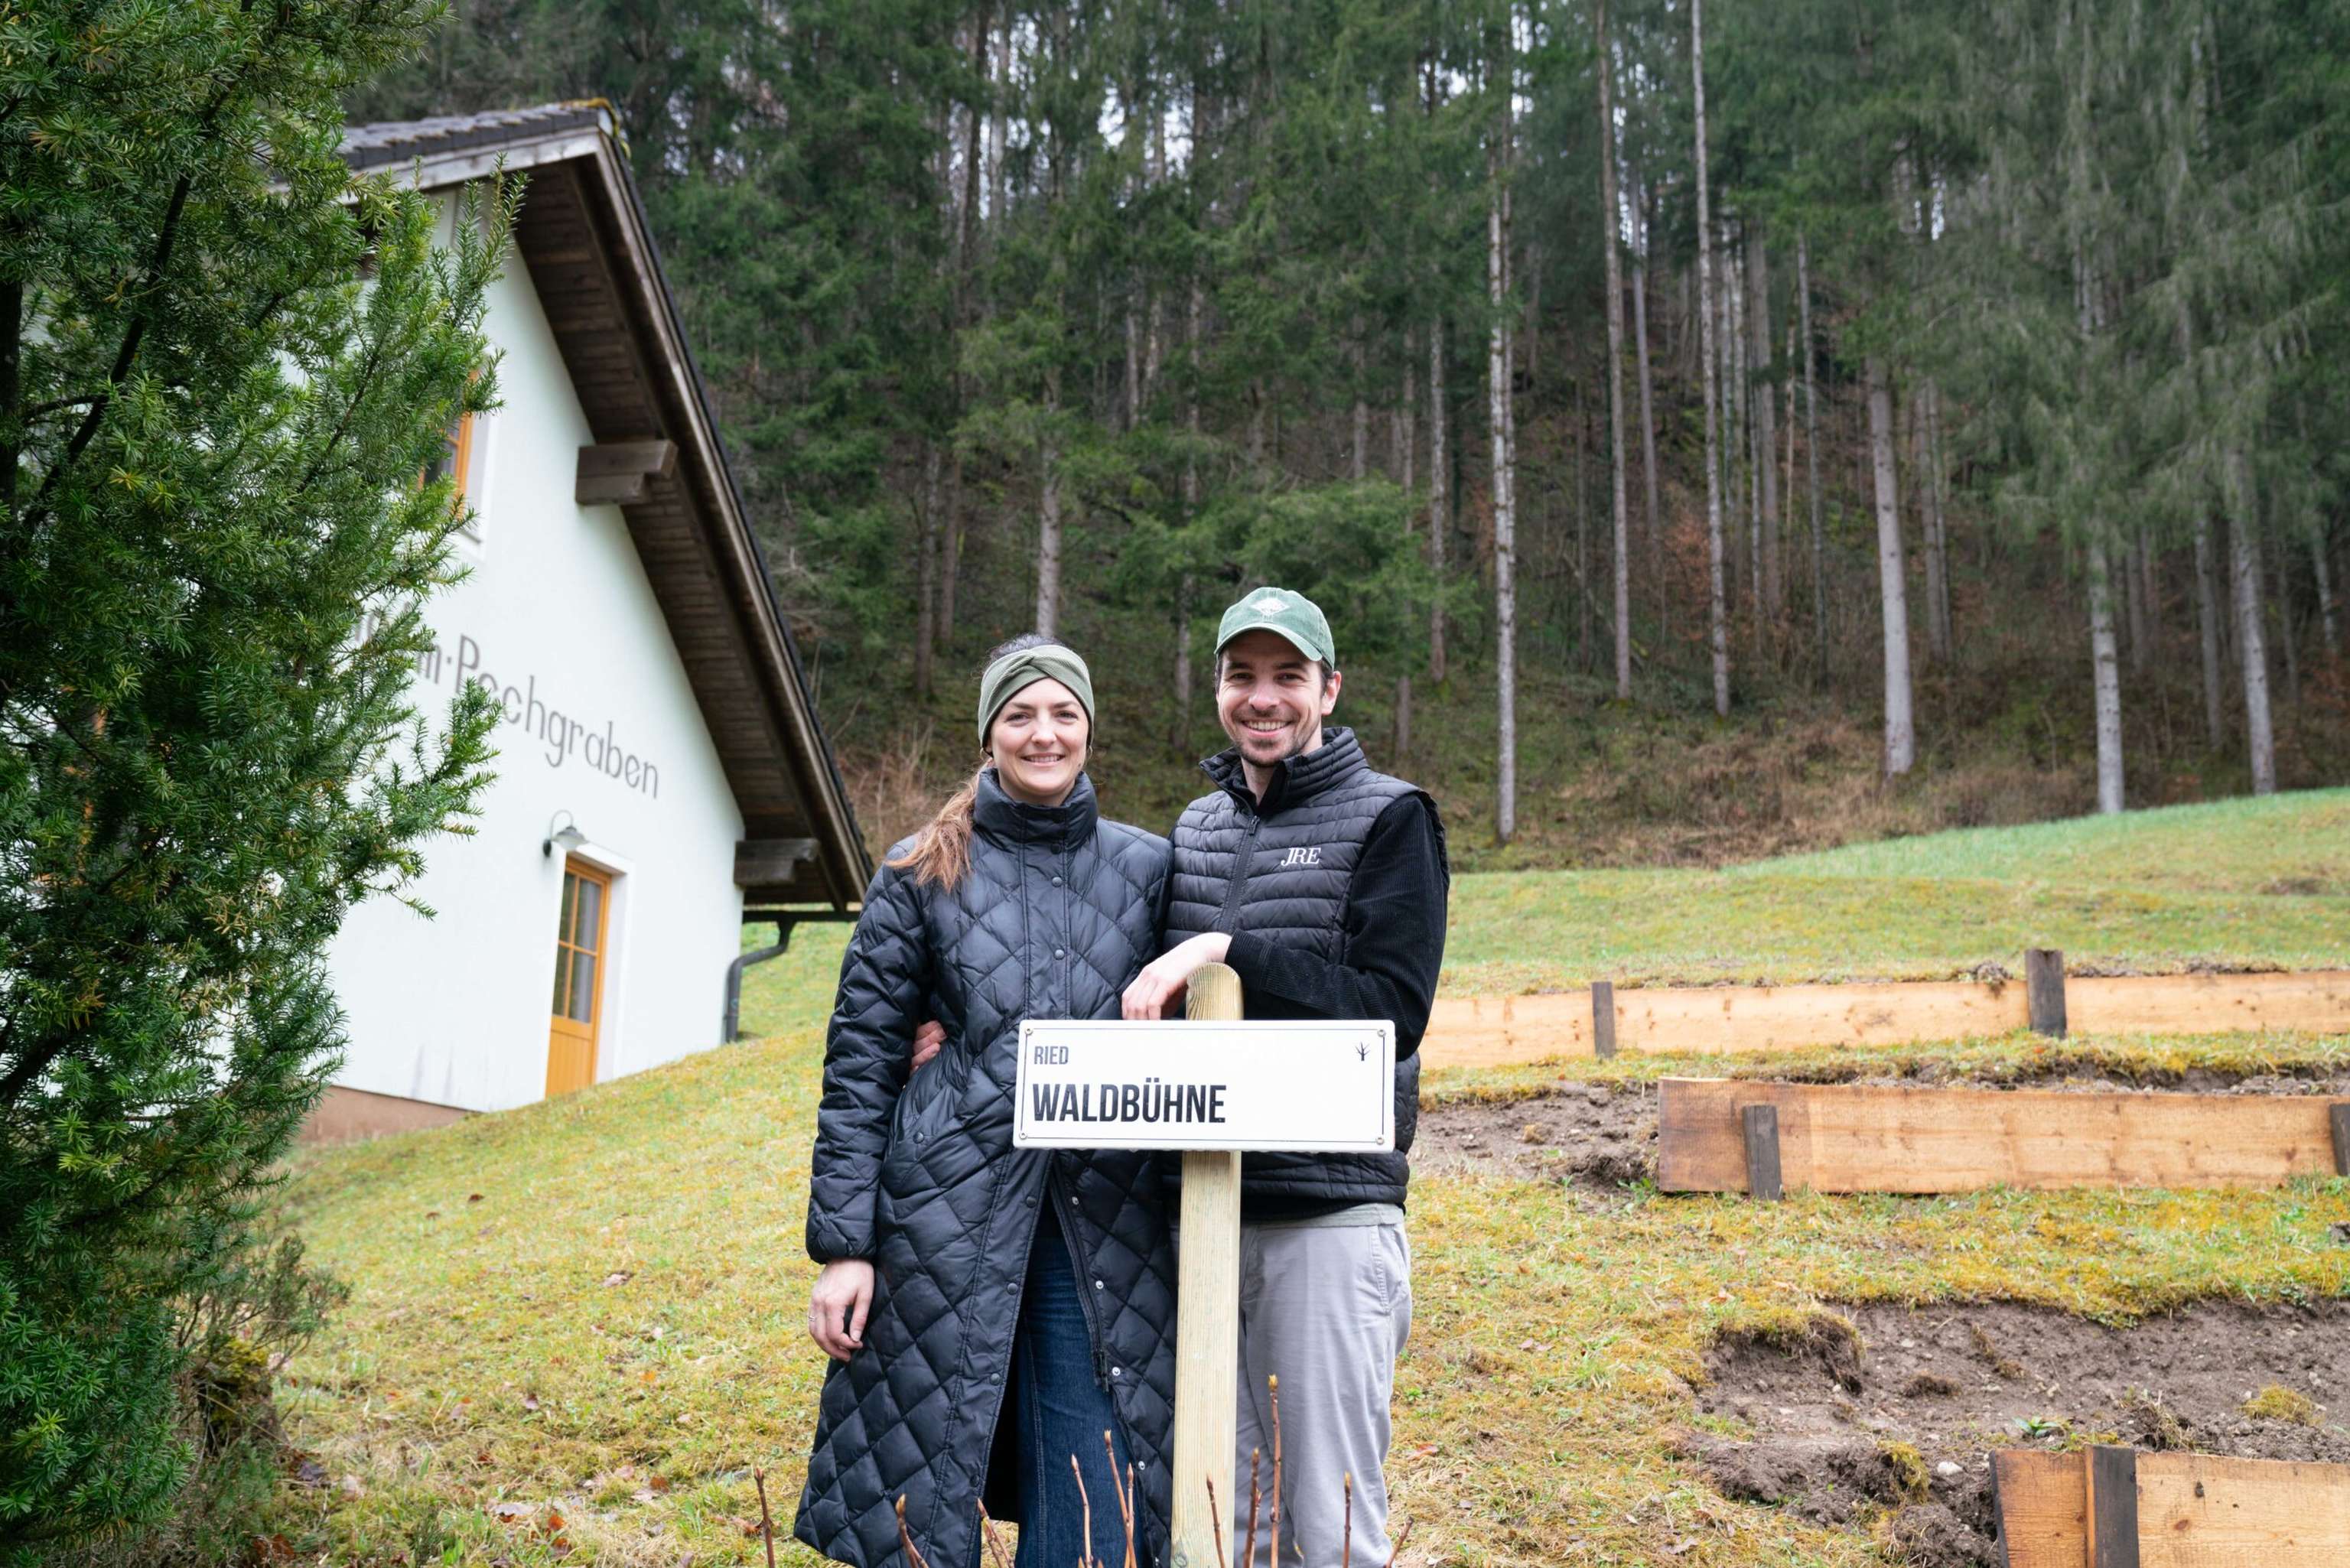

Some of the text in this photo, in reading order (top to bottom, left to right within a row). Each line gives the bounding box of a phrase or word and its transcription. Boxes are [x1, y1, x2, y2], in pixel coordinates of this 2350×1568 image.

[1281, 847, 1321, 867] JRE
[1034, 1046, 1069, 1065] RIED
[1033, 1077, 1227, 1124] WALDBÜHNE
